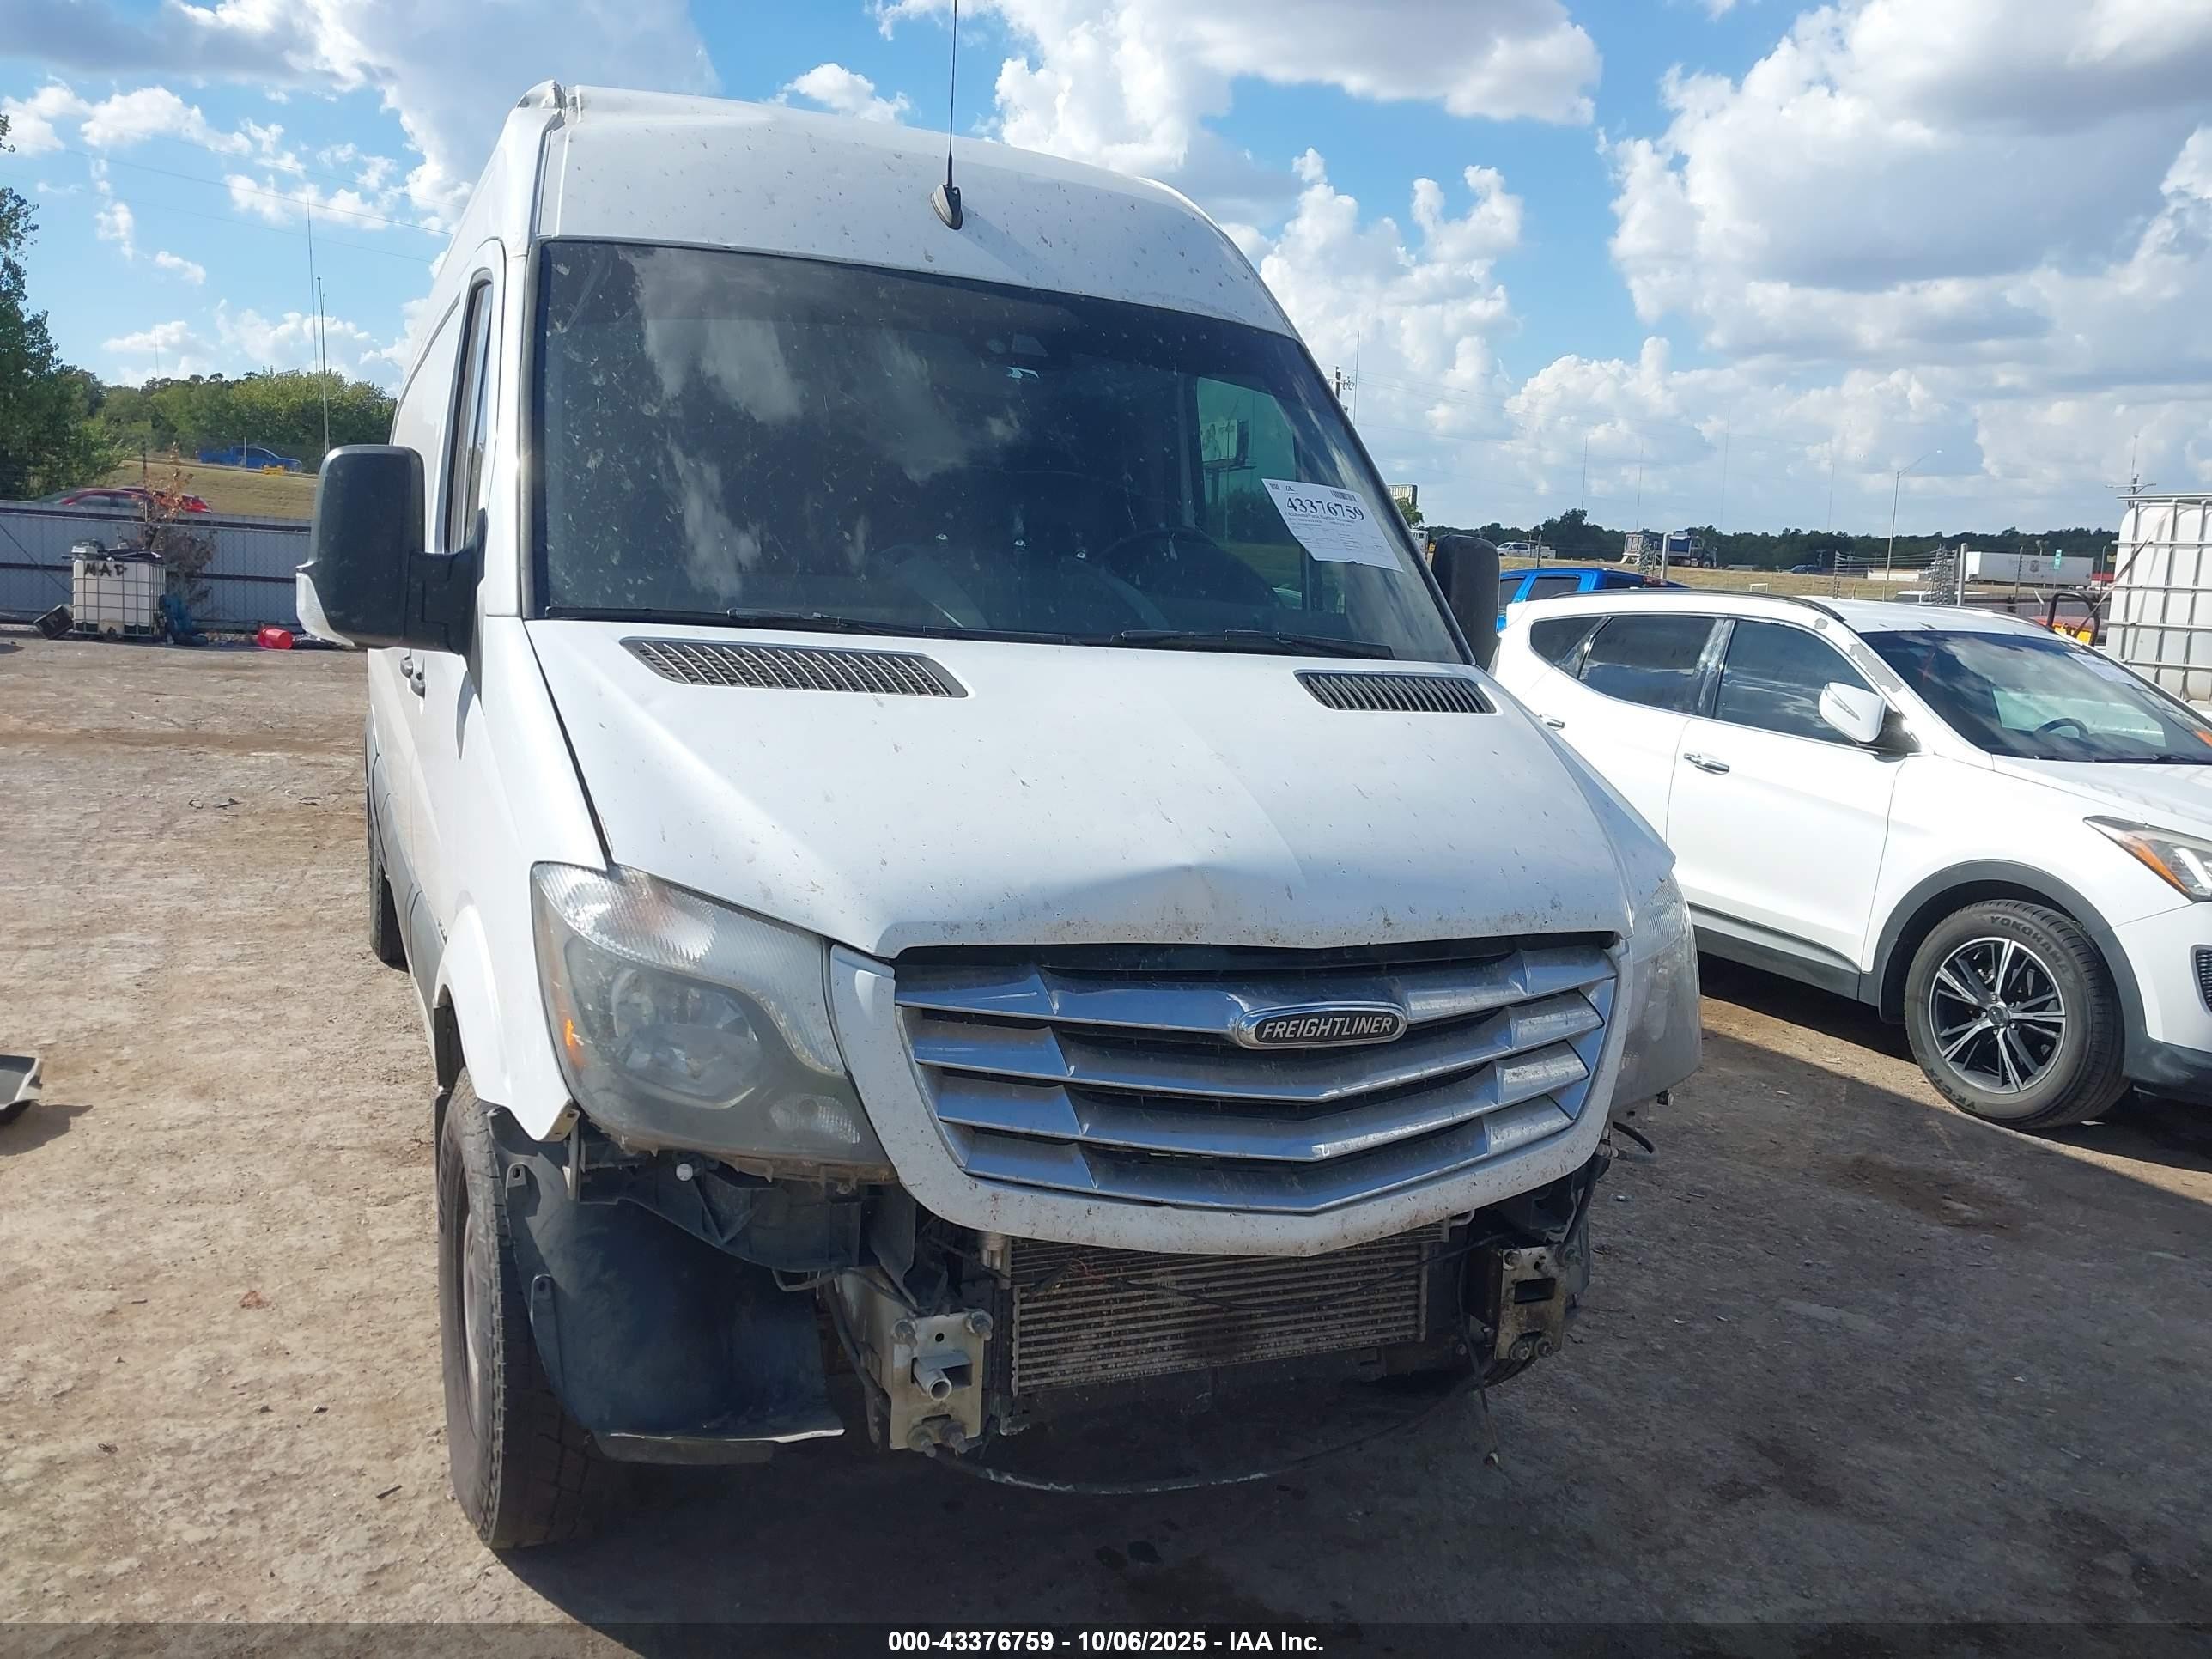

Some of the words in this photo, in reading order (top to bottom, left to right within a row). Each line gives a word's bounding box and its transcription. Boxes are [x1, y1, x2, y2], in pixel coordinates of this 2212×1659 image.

[1287, 497, 1364, 520] 43376759
[1990, 915, 2069, 975] YOKOHAMA
[1261, 1016, 1393, 1039] FREIGHTLINER
